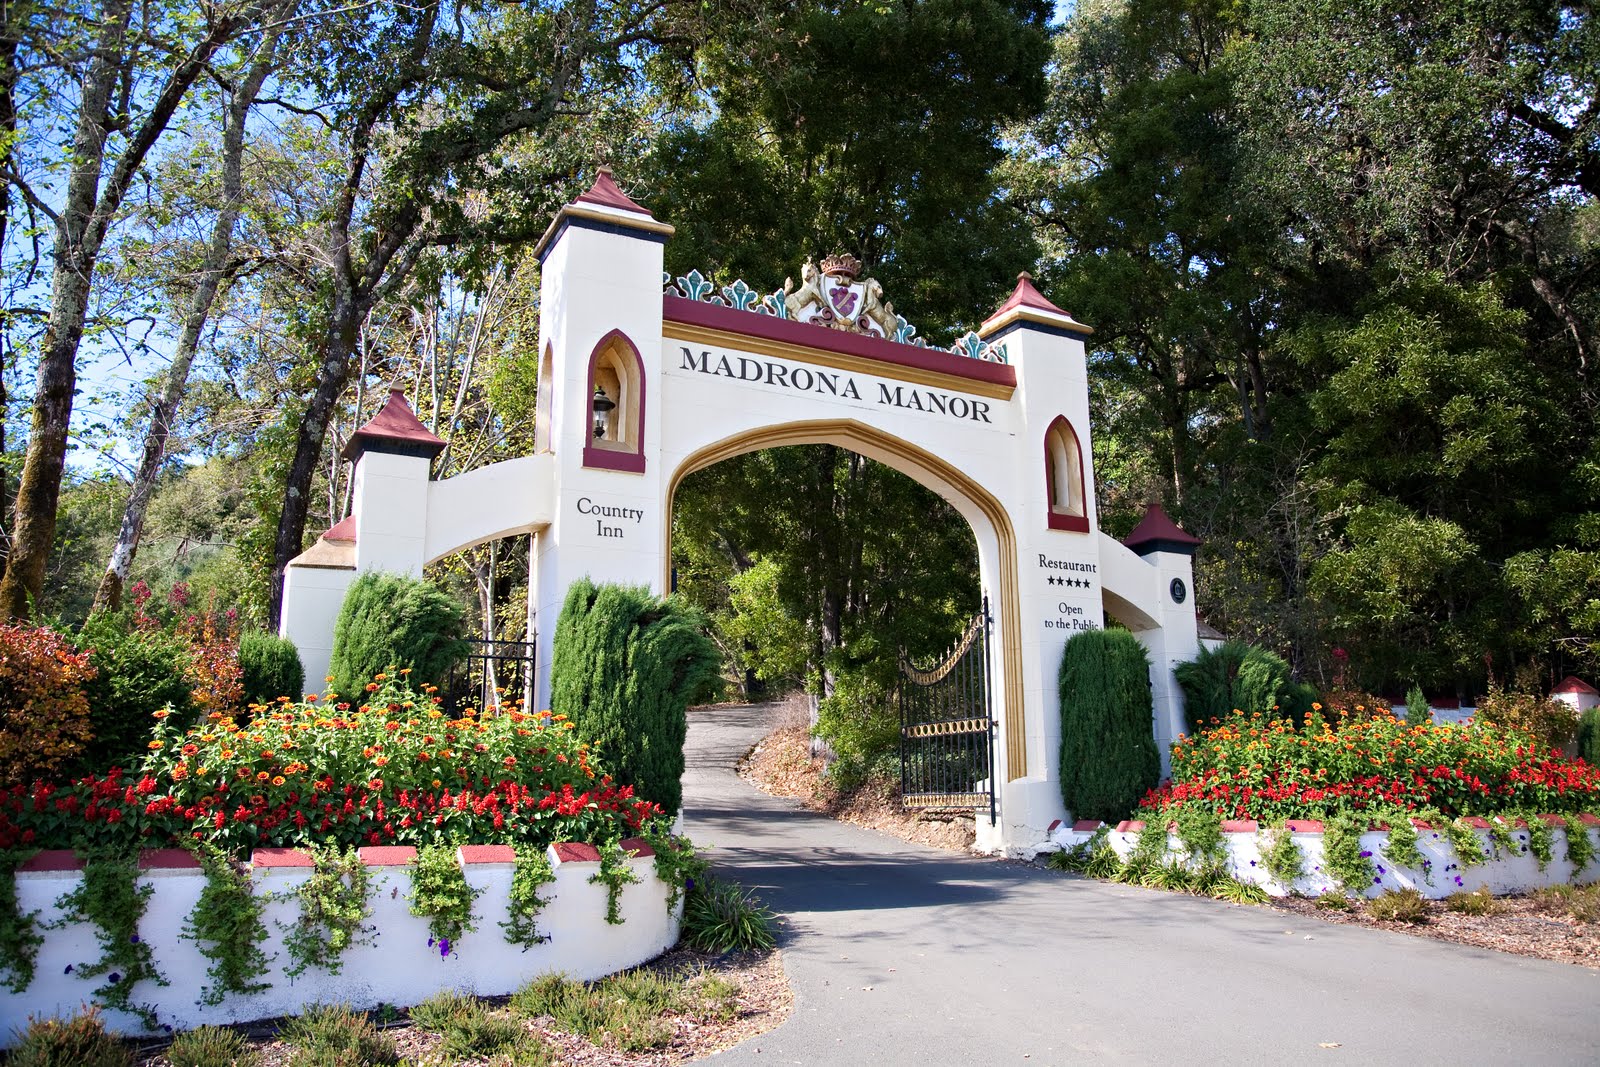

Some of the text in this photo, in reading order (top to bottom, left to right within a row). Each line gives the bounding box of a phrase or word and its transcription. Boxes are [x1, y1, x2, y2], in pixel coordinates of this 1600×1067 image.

[679, 346, 993, 424] MADRONA MANOR
[576, 497, 644, 524] Country
[596, 519, 624, 538] Inn
[1038, 553, 1097, 573] Restaurant
[1058, 602, 1083, 616] Open
[1044, 617, 1099, 631] to the Public
